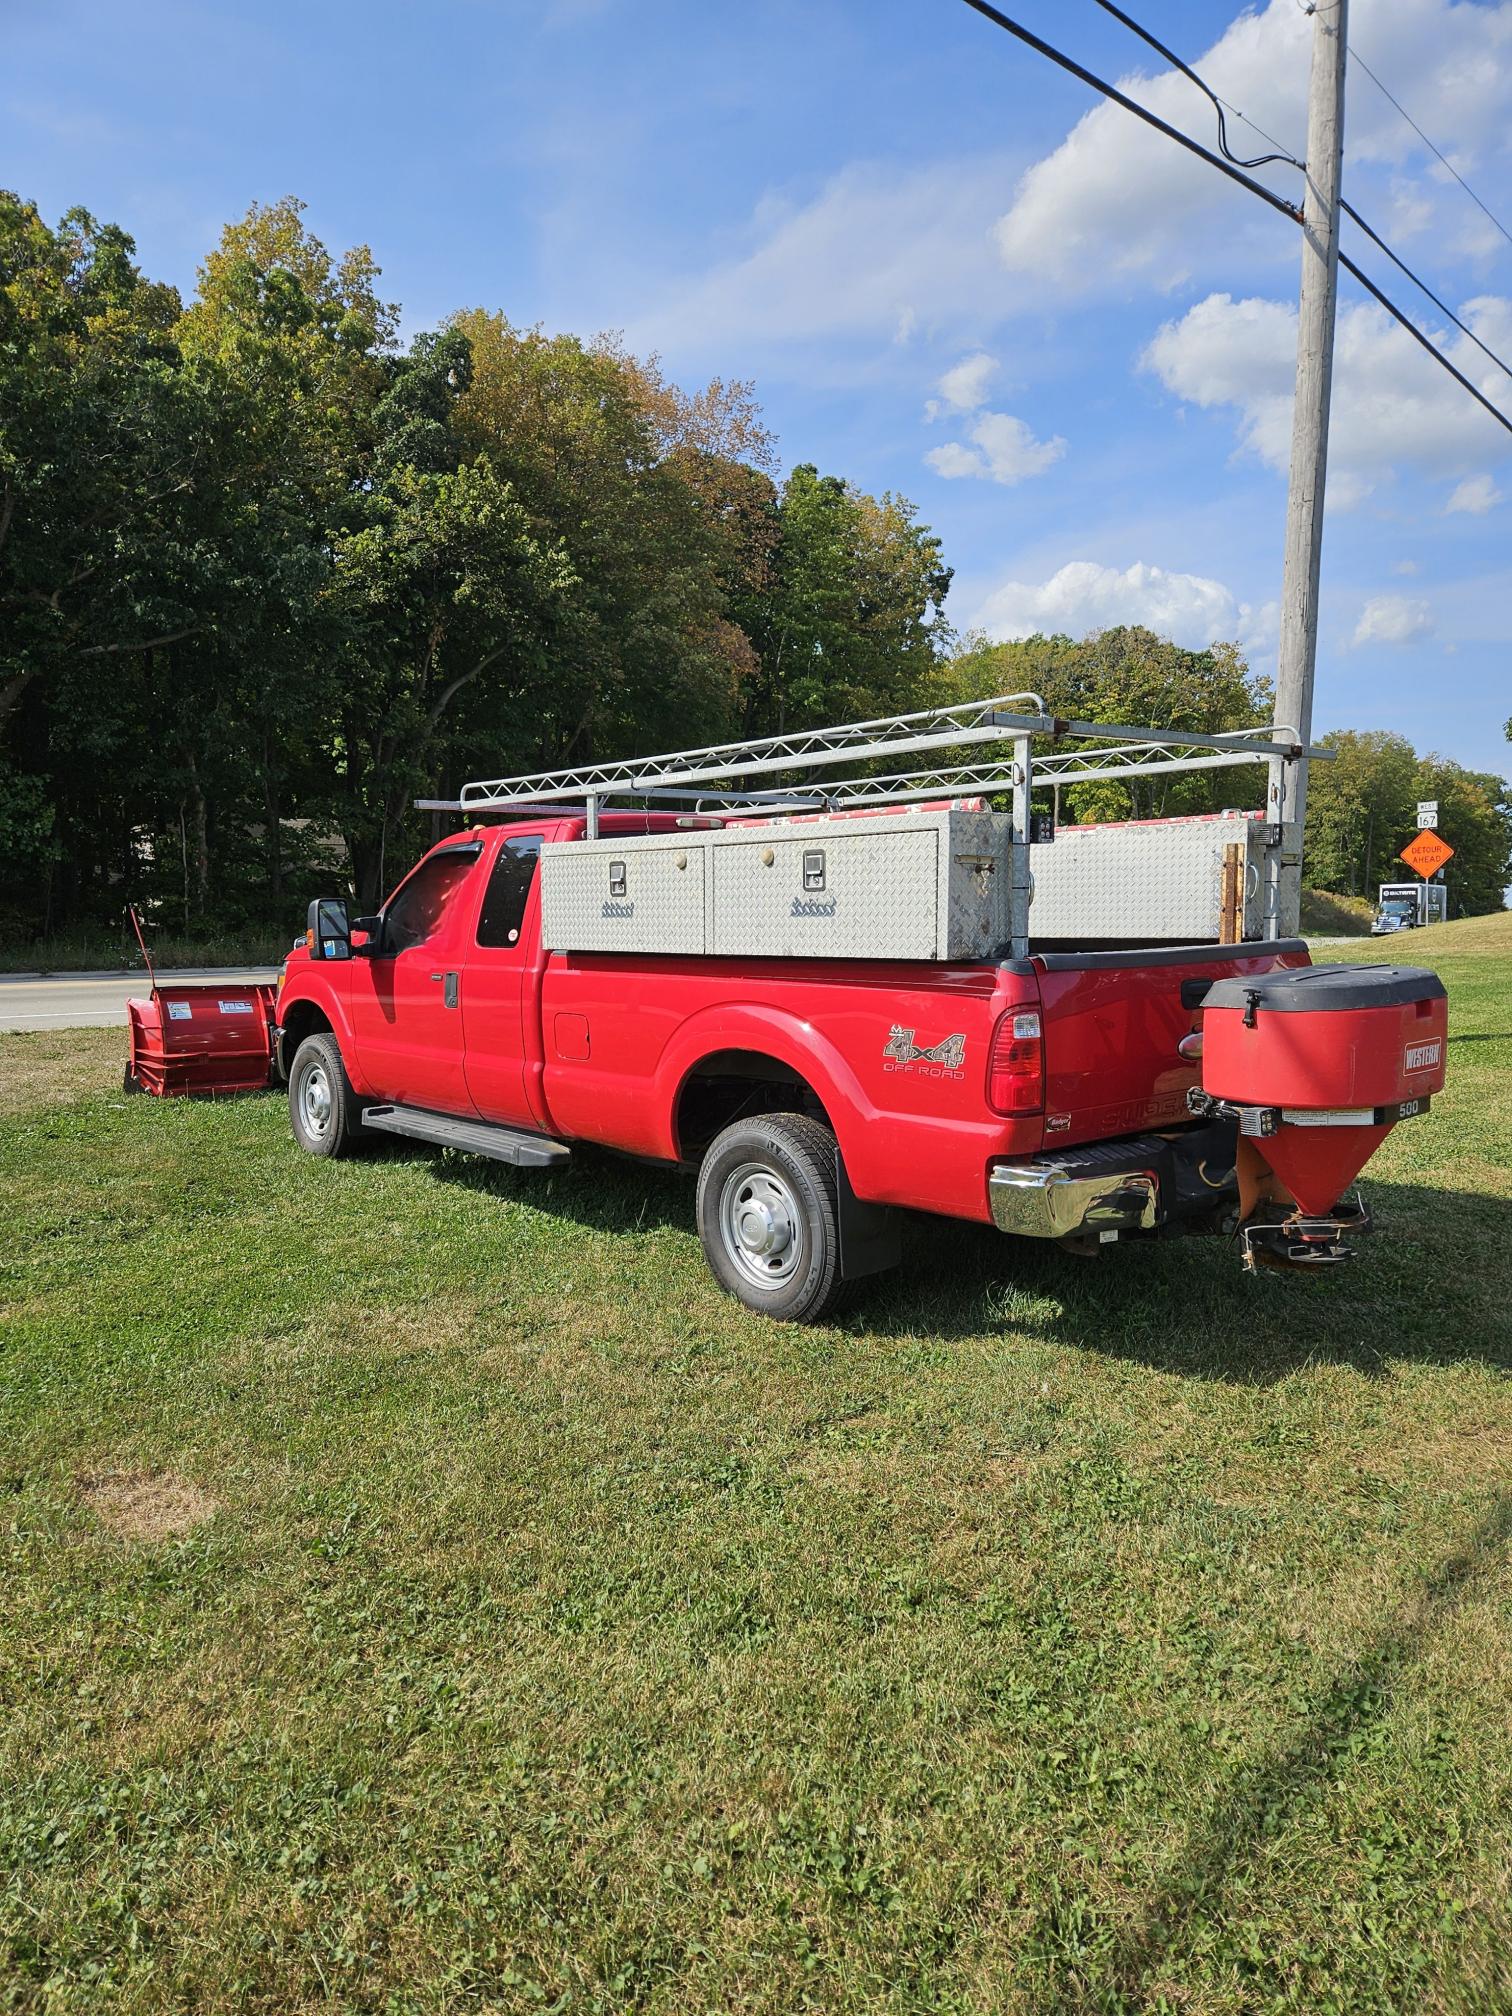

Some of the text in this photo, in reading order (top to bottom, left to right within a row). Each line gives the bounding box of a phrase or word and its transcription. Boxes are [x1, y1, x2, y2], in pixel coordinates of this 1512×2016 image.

[1419, 815, 1436, 826] 167
[1411, 845, 1442, 854] DETOUR
[1412, 855, 1441, 864] AHEAD
[1406, 1043, 1440, 1070] WESTERN
[883, 1063, 965, 1080] OFF ROAD
[1399, 1099, 1419, 1117] 500
